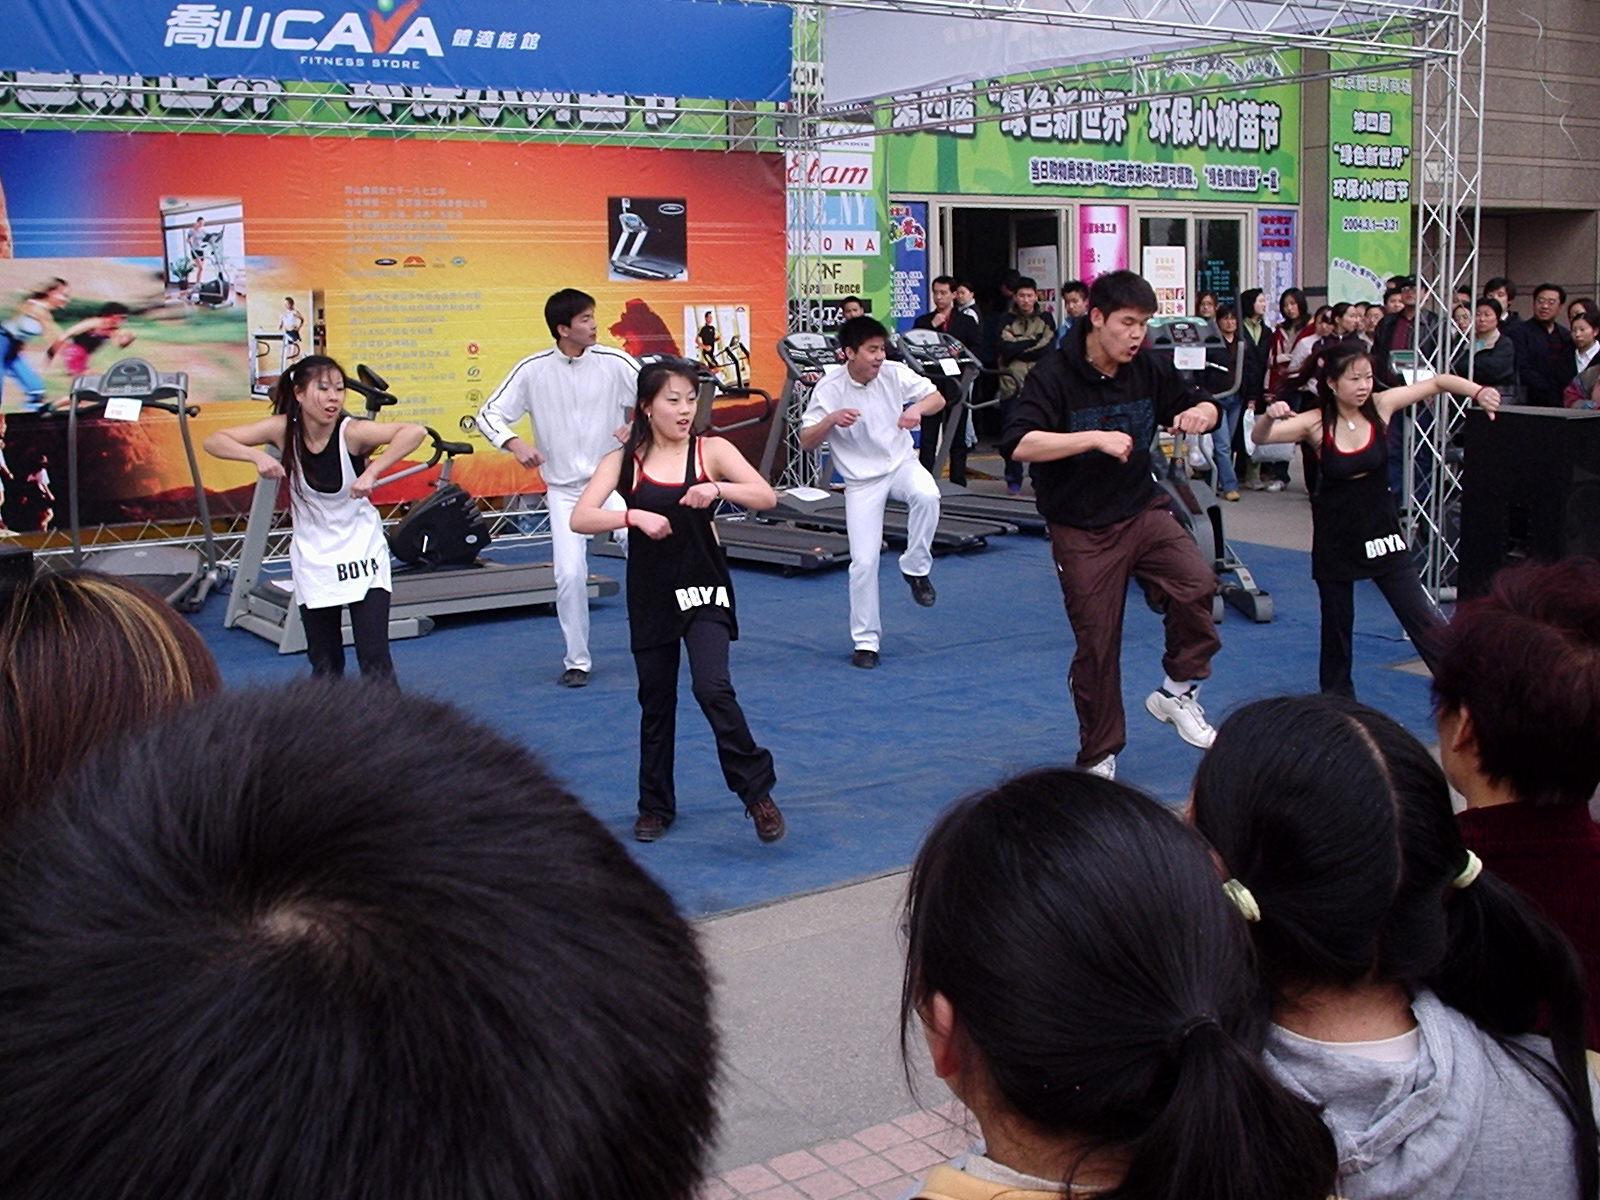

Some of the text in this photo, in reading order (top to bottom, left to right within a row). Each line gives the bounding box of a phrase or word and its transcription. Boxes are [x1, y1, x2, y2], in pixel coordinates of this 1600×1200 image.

[300, 55, 421, 70] FITNESS STORE
[1148, 96, 1282, 150] 环保小树苗节
[1333, 178, 1410, 201] 环保小树苗节
[834, 283, 861, 294] Fence
[1365, 533, 1406, 559] BOYA
[674, 586, 731, 612] BOYA
